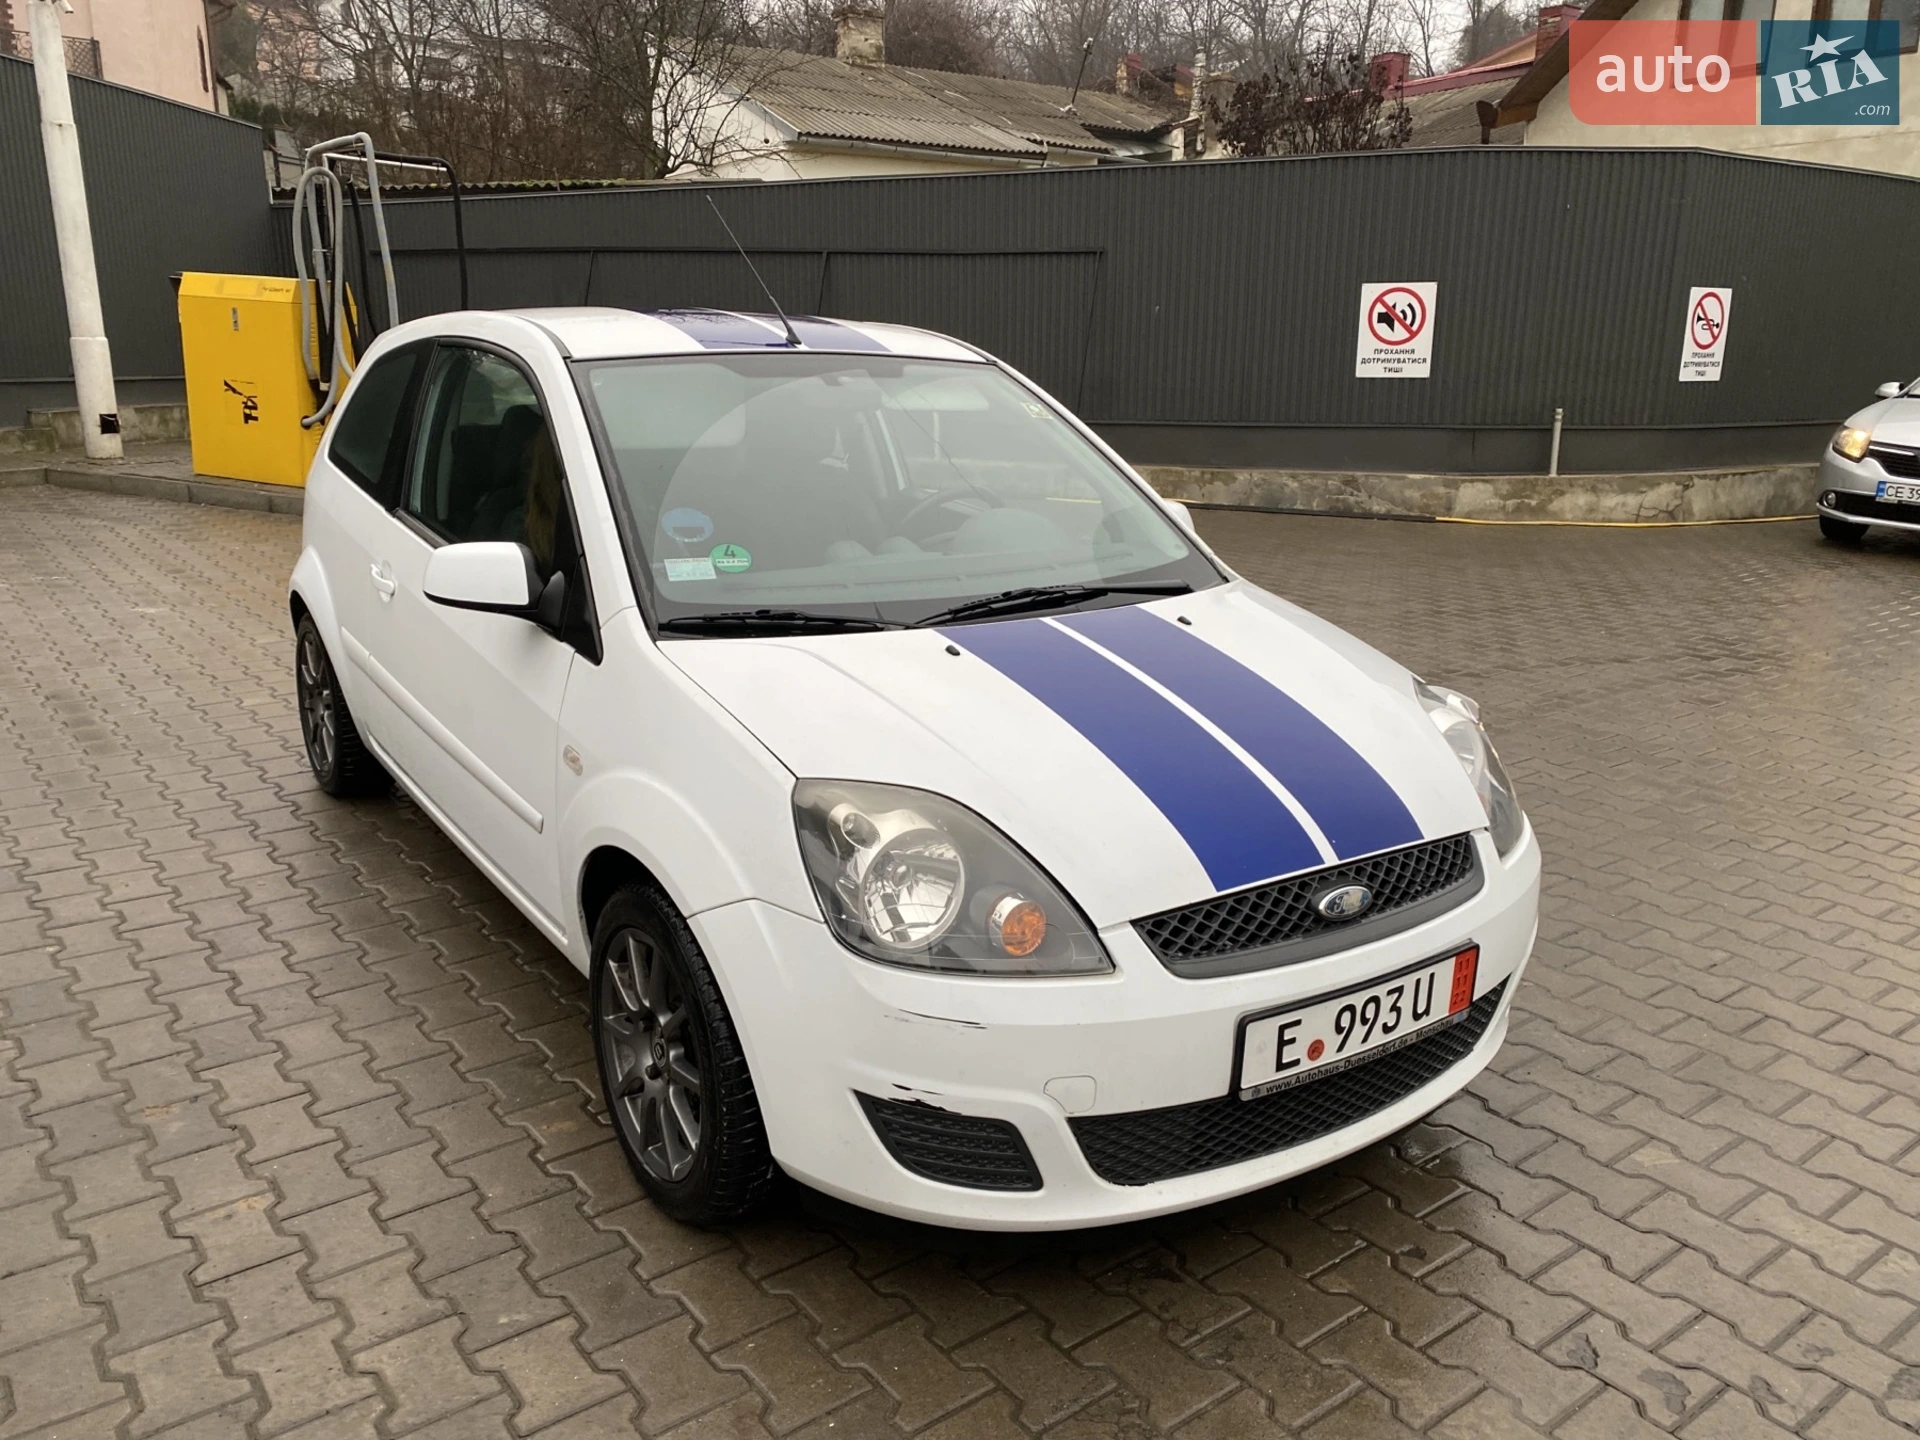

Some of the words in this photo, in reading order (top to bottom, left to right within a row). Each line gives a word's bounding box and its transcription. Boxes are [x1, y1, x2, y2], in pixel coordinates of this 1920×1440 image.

[1360, 357, 1427, 365] ДОТРИМУВАТИСЯ
[1886, 485, 1905, 498] CE
[724, 544, 736, 558] 4
[1458, 957, 1470, 973] 11
[1456, 973, 1468, 989] 11
[1452, 989, 1466, 1006] 22
[1275, 1018, 1302, 1073] E
[1335, 985, 1405, 1053] 993
[1412, 972, 1435, 1022] U
[1416, 1018, 1454, 1040] Monschau
